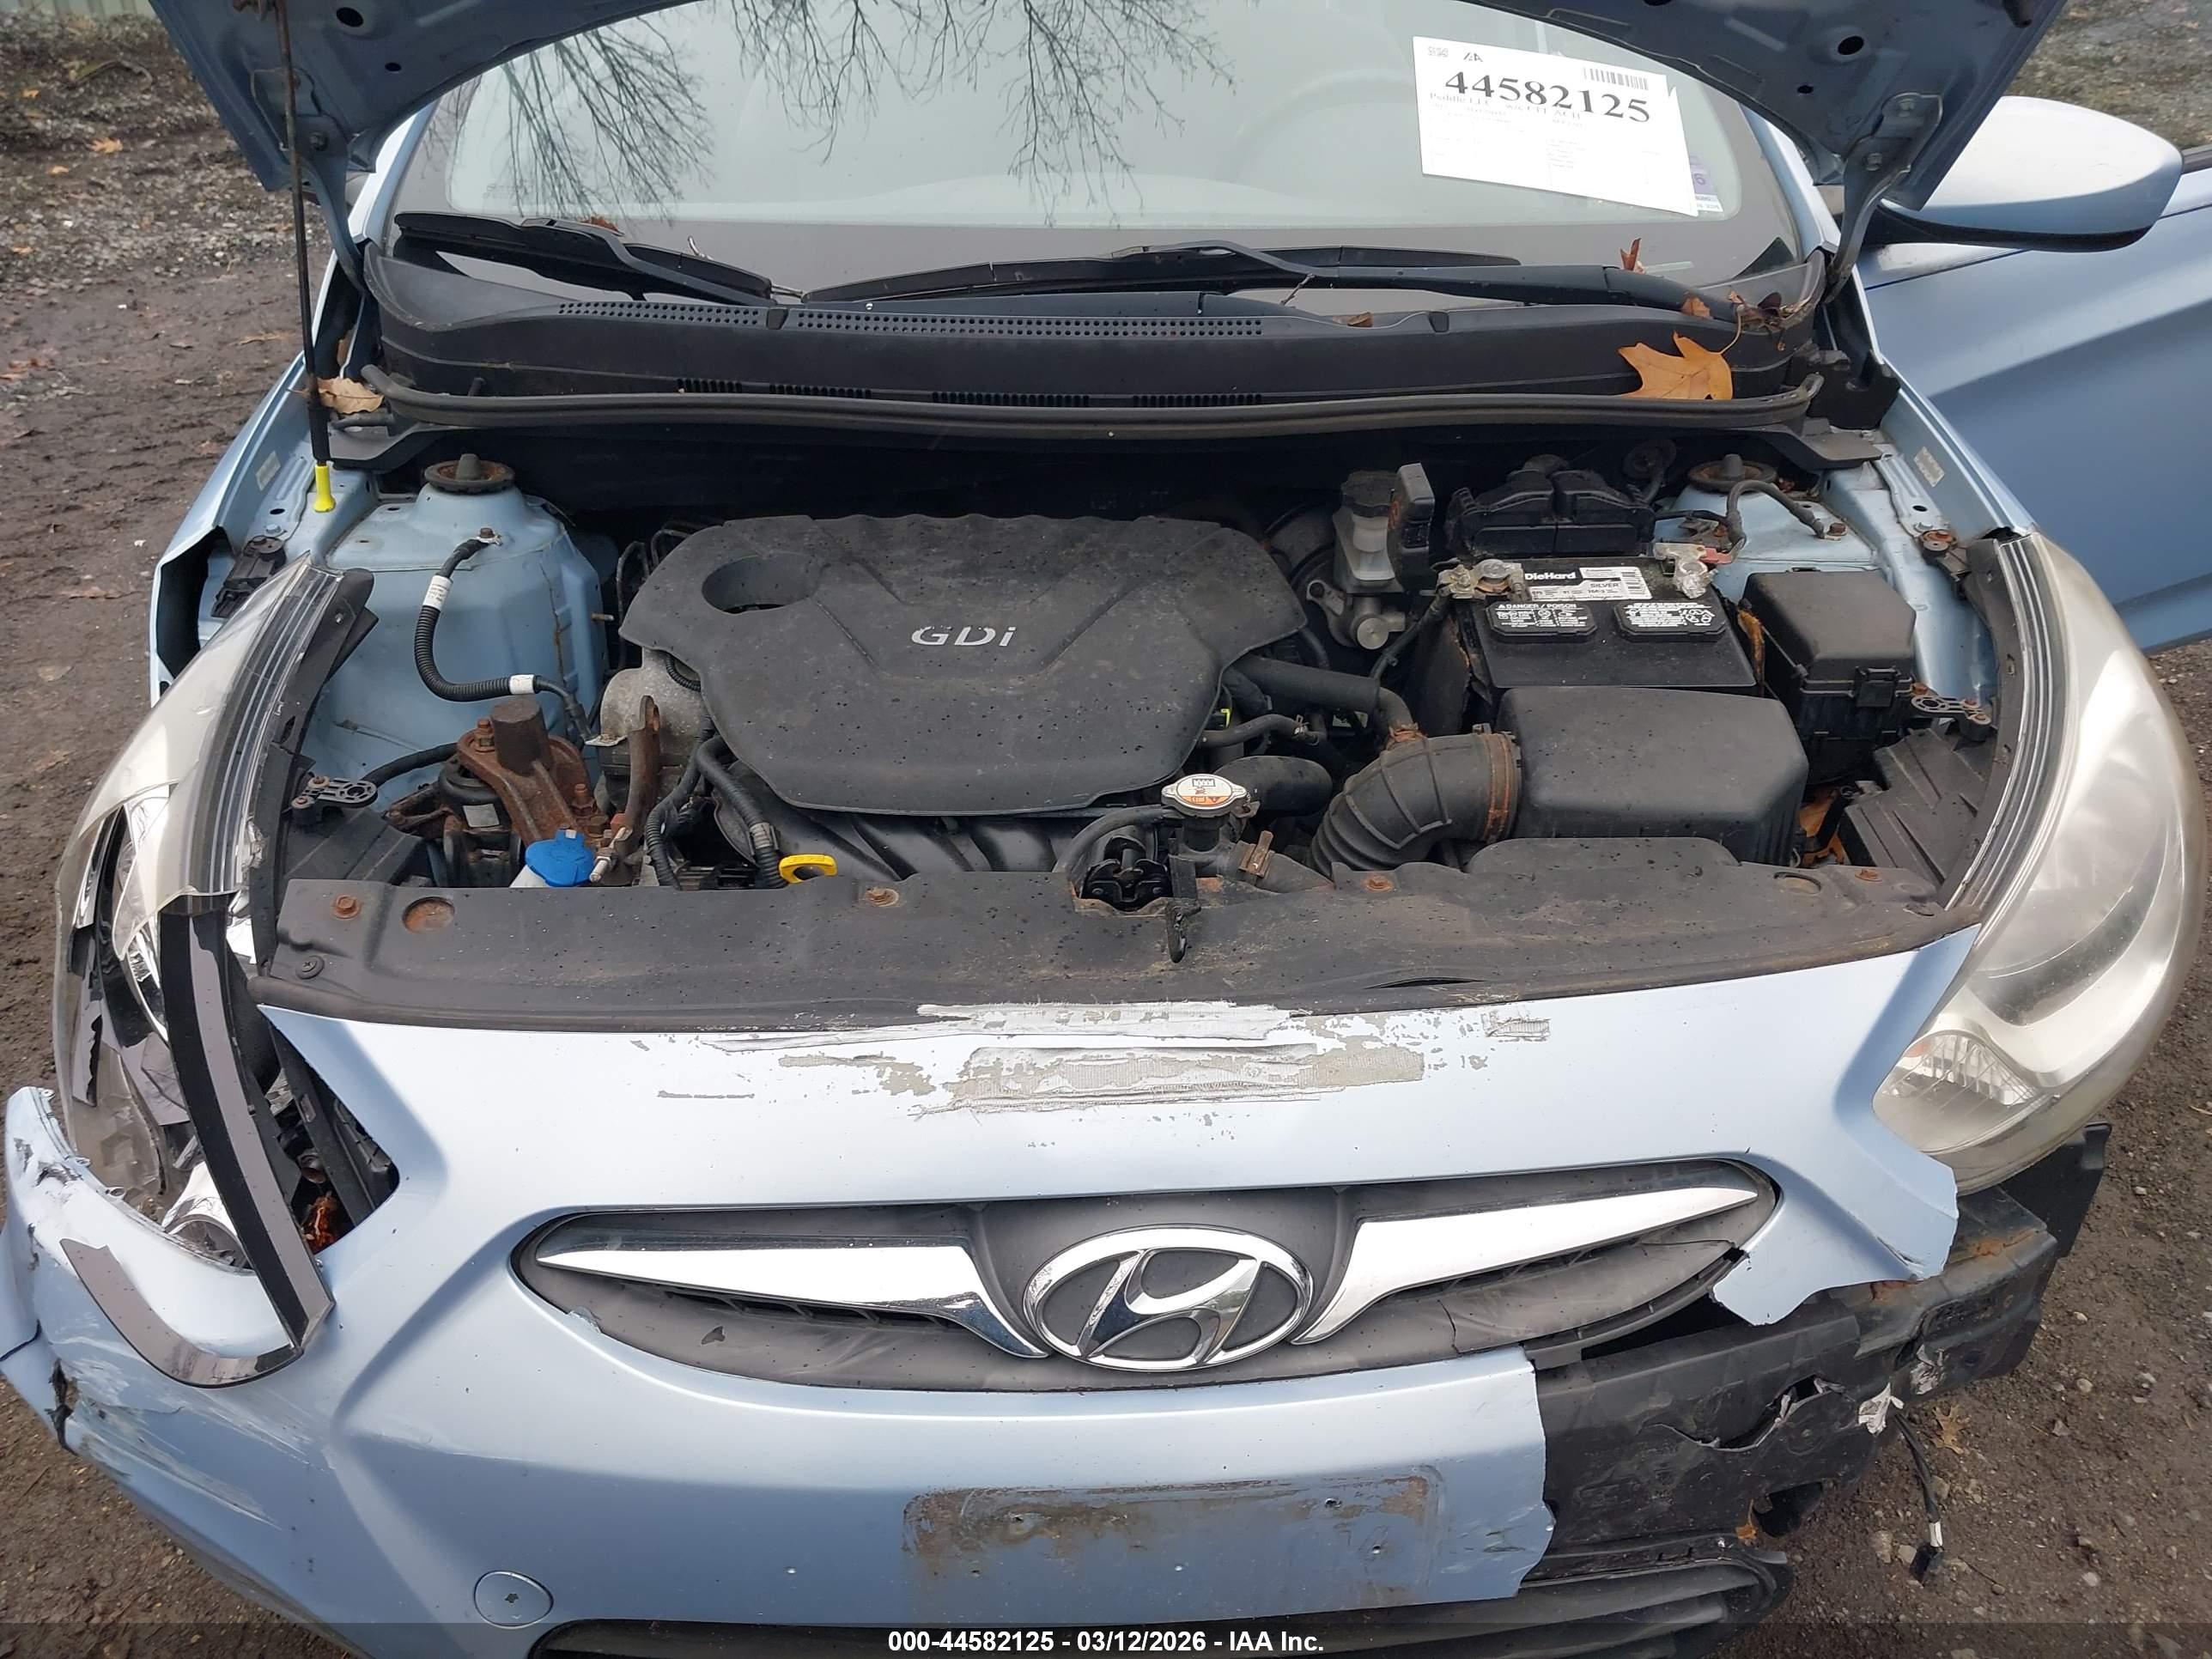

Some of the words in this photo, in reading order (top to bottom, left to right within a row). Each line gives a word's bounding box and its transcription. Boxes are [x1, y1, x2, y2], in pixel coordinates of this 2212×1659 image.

[1444, 70, 1650, 123] 44582125
[1524, 571, 1577, 580] DieHard
[910, 625, 1018, 647] GDi
